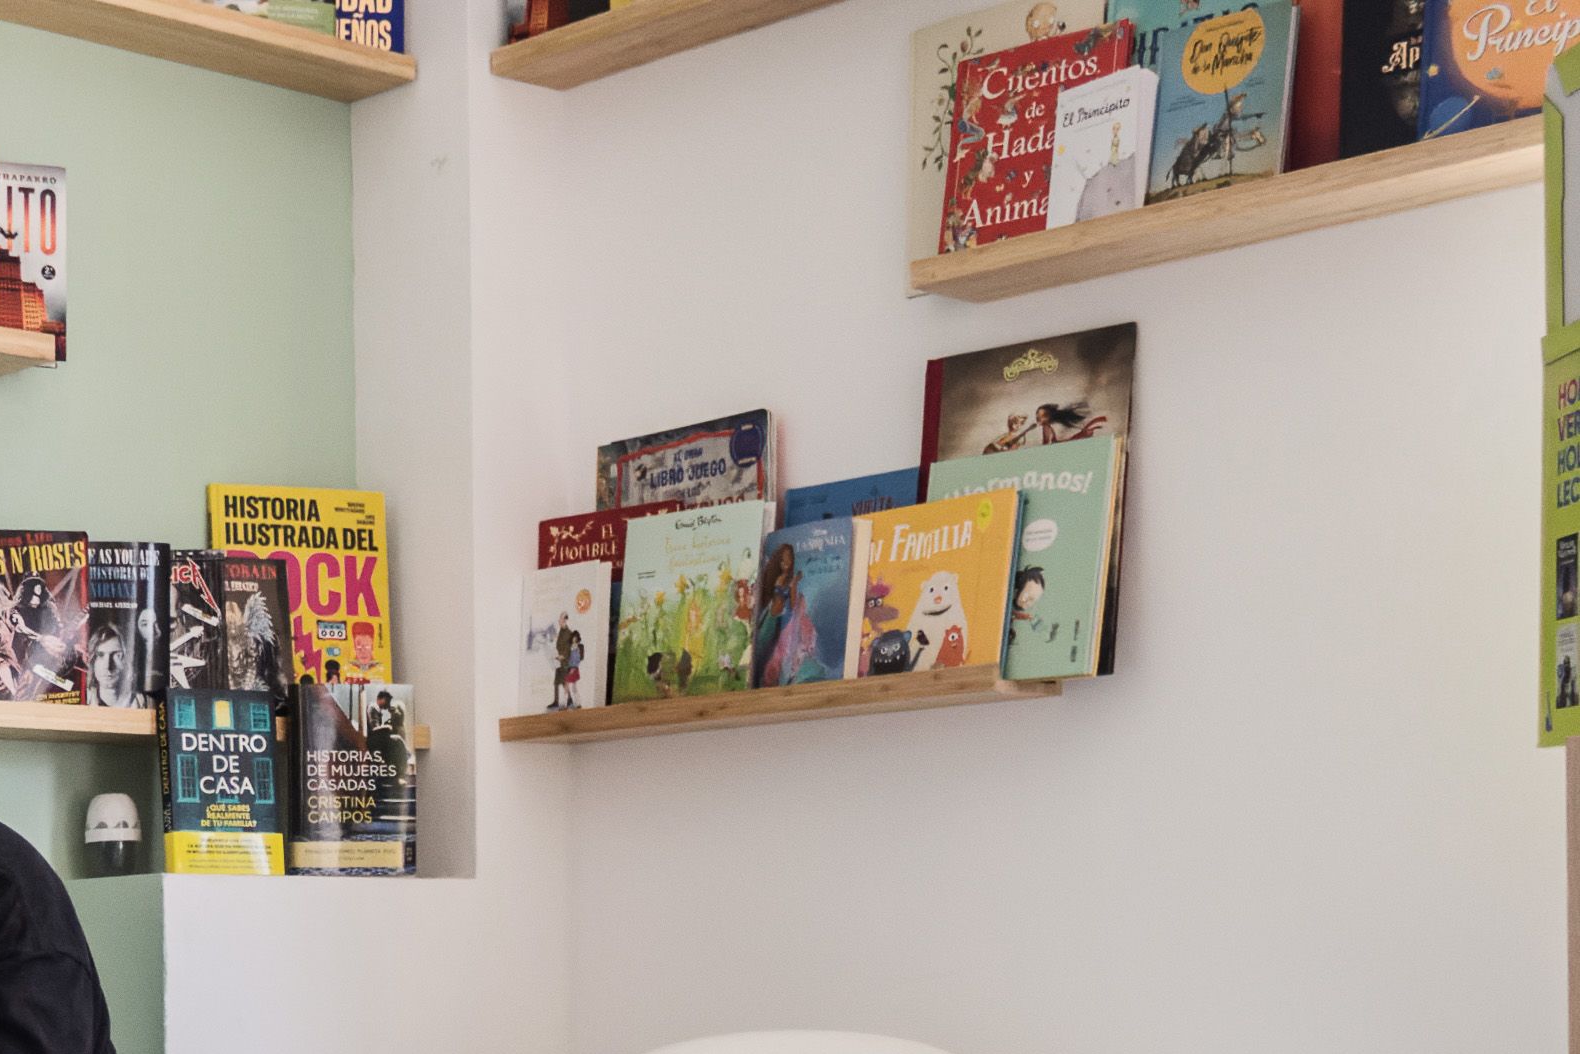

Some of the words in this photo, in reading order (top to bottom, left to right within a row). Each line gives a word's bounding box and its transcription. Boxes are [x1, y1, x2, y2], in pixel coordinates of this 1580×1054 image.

[981, 55, 1099, 100] Cuentos
[1024, 101, 1046, 120] de
[1021, 169, 1035, 188] y
[1558, 378, 1580, 410] HO
[1557, 444, 1580, 476] HO
[649, 466, 685, 489] LIBRO
[688, 457, 726, 481] JUEGO
[224, 495, 321, 522] HISTORIA
[225, 522, 339, 550] ILUSTRADA
[343, 528, 379, 551] DEL
[890, 520, 973, 562] FAMILIA
[29, 540, 86, 572] ROSES
[98, 548, 113, 565] AS
[226, 550, 381, 617] OCK
[181, 732, 267, 753] DENTRO
[212, 755, 241, 774] DE
[307, 765, 327, 777] DE
[331, 765, 397, 777] MUJERES
[199, 776, 255, 796] CASA
[307, 779, 376, 791] CASADAS
[308, 796, 376, 808] CRISTINA
[308, 811, 372, 824] CAMPOS
